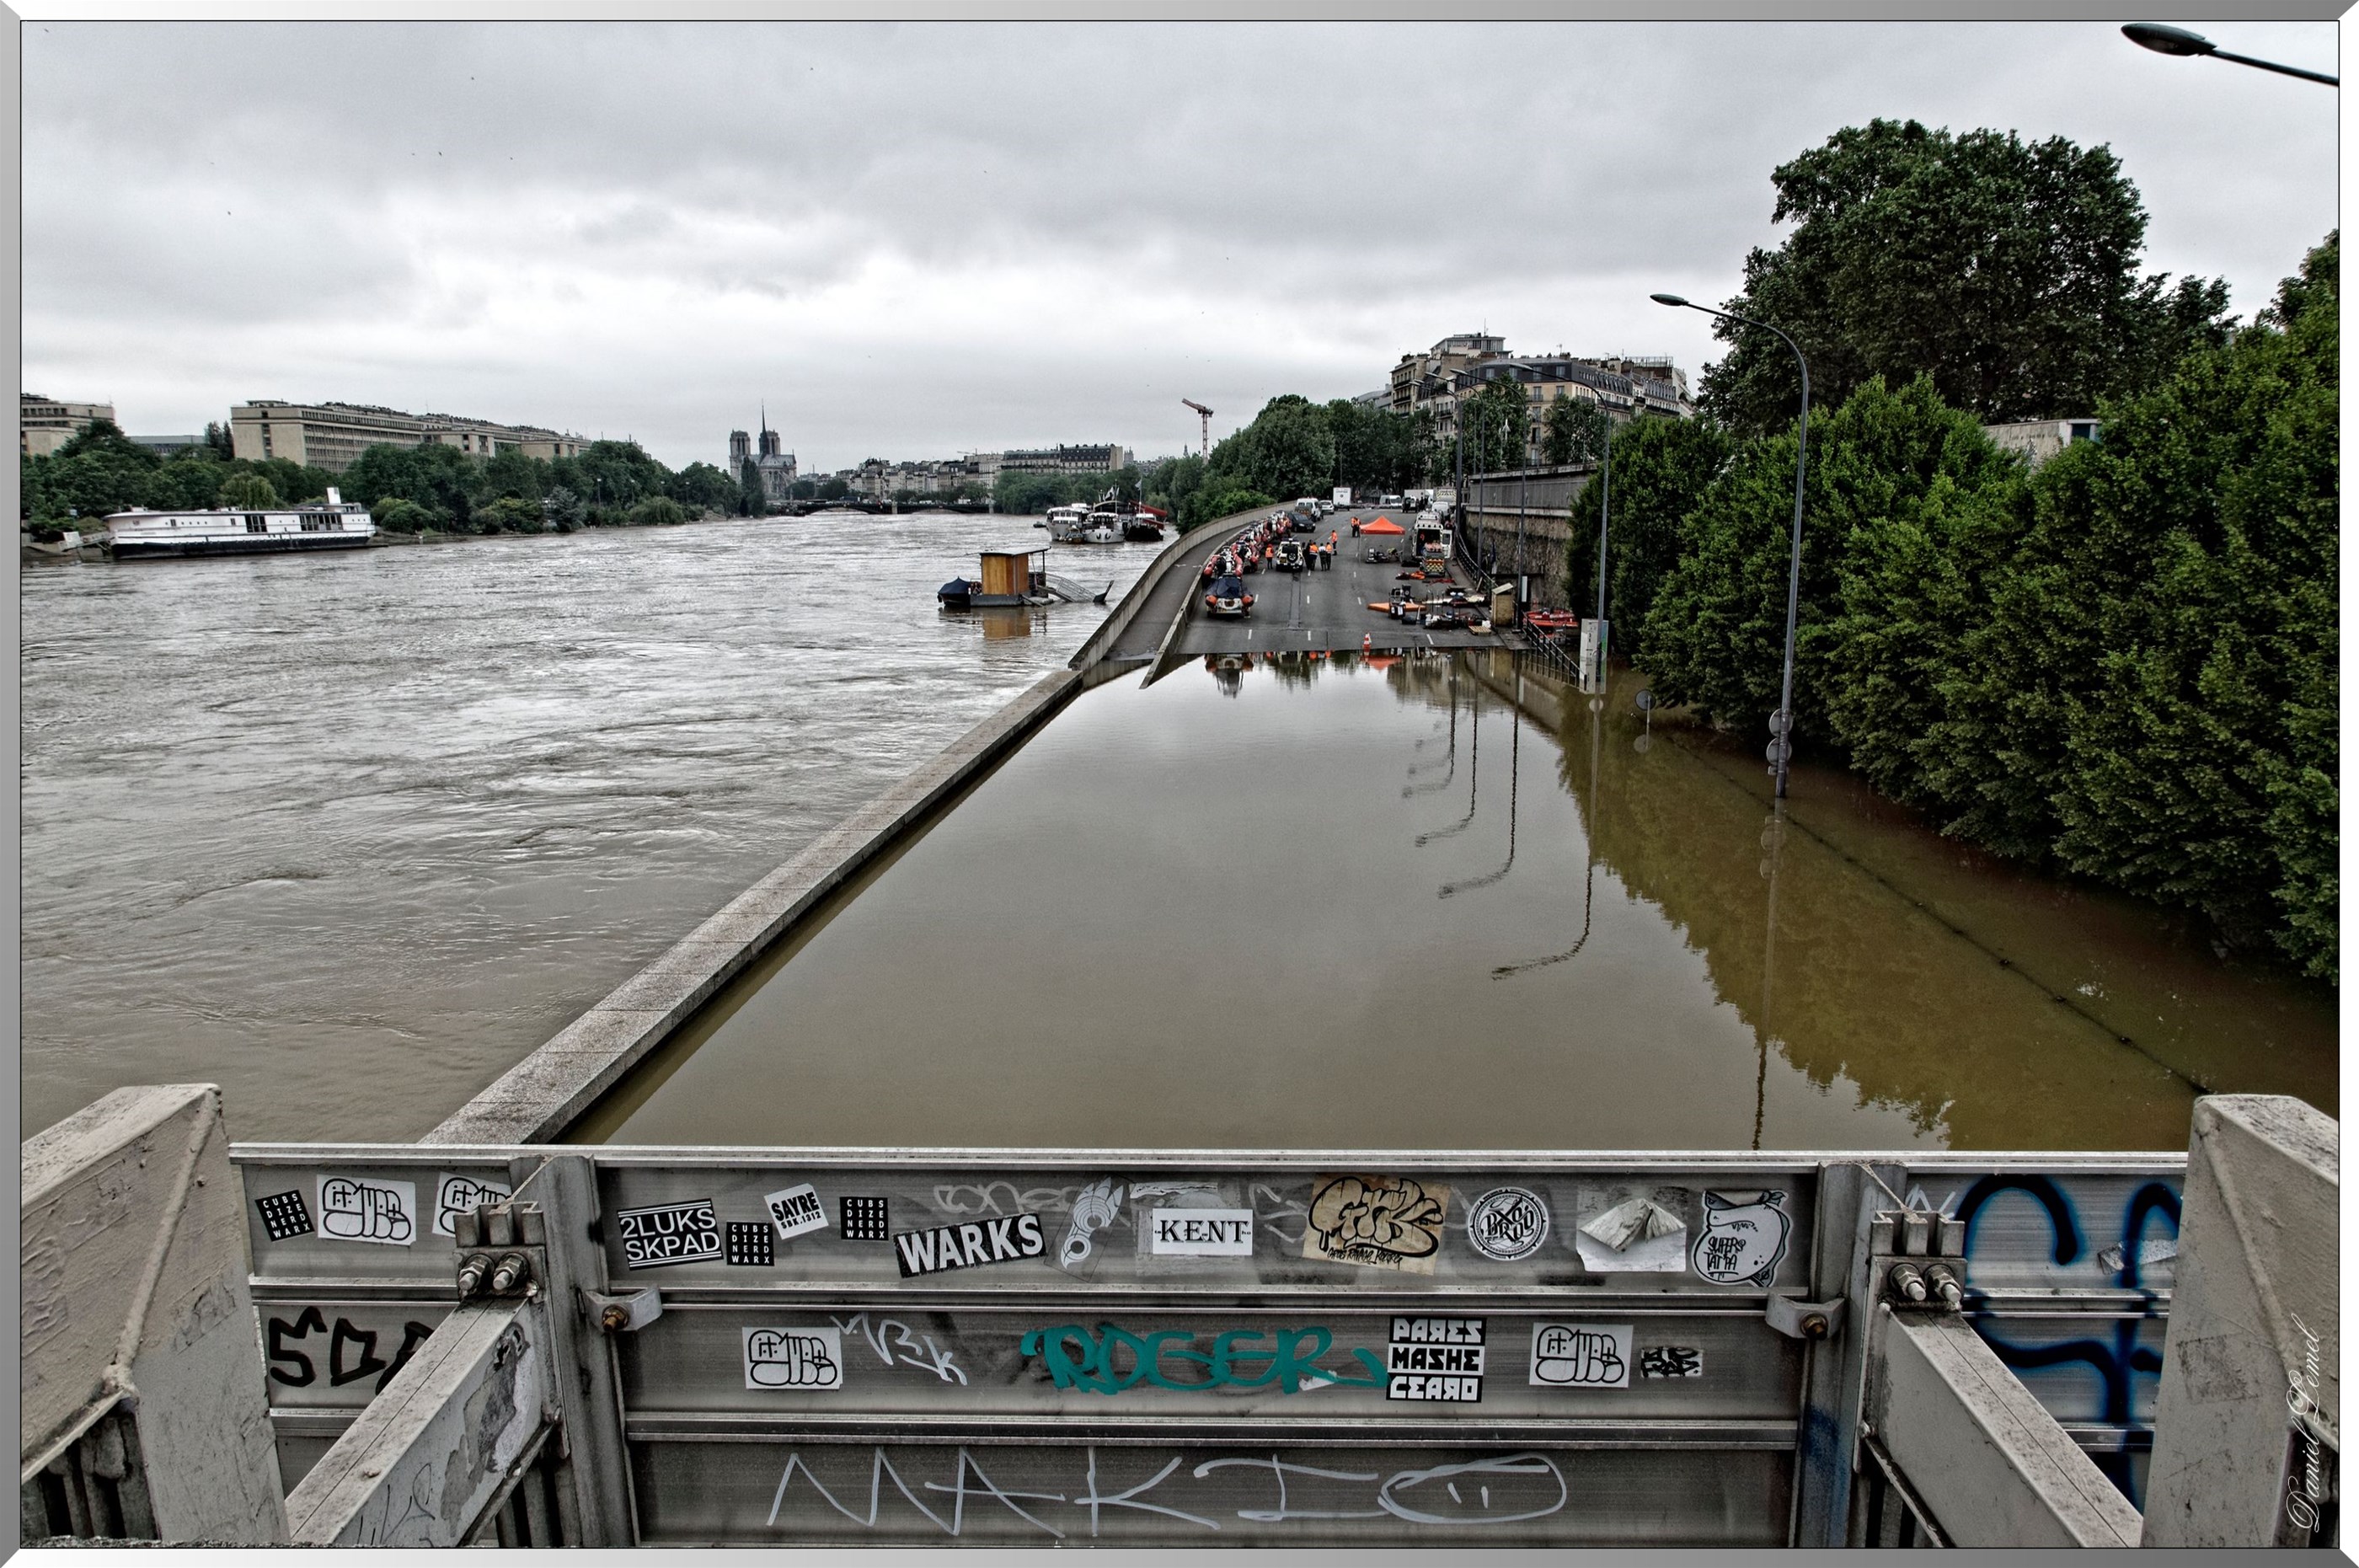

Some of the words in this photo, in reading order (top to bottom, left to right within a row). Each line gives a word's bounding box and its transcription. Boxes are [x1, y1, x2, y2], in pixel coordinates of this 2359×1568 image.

[263, 1193, 299, 1208] CUBS
[771, 1191, 820, 1222] SAYRE
[846, 1198, 885, 1208] CUBS
[266, 1203, 302, 1218] DIZE
[846, 1209, 885, 1219] DIZE
[270, 1213, 307, 1228] NERD
[620, 1207, 717, 1239] 2LUKS
[847, 1219, 885, 1229] NERD
[273, 1223, 311, 1239] WARX
[731, 1224, 769, 1234] CUBS
[846, 1229, 885, 1239] WARX
[1160, 1219, 1250, 1244] KENT
[625, 1231, 721, 1260] SKPAD
[731, 1234, 769, 1244] DIZE
[897, 1215, 1044, 1273] WARKS
[731, 1244, 770, 1255] NERD
[731, 1255, 770, 1265] WARX
[1393, 1318, 1483, 1343] PARES
[1392, 1346, 1480, 1372] MASHE
